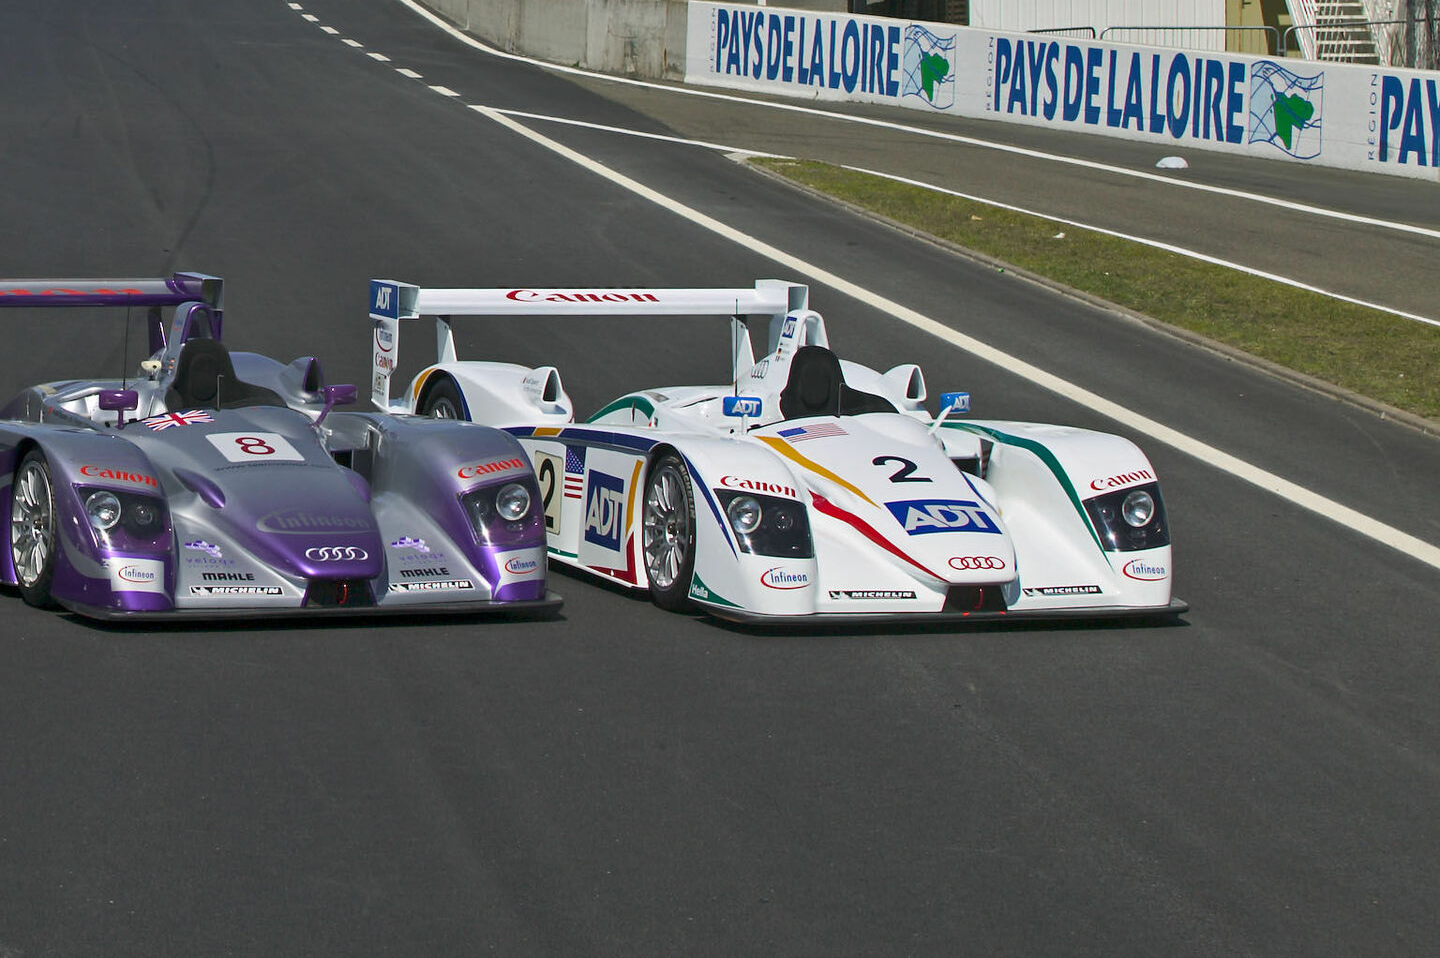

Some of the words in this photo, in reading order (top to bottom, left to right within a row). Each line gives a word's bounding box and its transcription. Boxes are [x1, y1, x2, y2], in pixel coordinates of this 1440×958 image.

[716, 8, 765, 80] PAYS
[766, 14, 795, 82] DE
[797, 17, 825, 87] LA
[829, 19, 901, 98] LOIRE
[994, 37, 1060, 121] PAYS
[1063, 45, 1104, 125] DE
[1107, 49, 1144, 132] LA
[1149, 52, 1247, 145] LOIRE
[375, 287, 392, 310] ADT
[505, 289, 661, 303] Canon
[782, 319, 796, 335] ADT
[731, 399, 761, 415] ADT
[952, 395, 970, 411] ADT
[235, 436, 276, 455] 8
[79, 465, 157, 489] Canon
[457, 458, 525, 479] Canon
[872, 455, 934, 483] 2
[720, 475, 796, 498] Canon
[1090, 469, 1152, 491] Canon
[539, 458, 555, 528] 2
[585, 484, 624, 541] ADT
[905, 504, 990, 531] ADT
[201, 572, 255, 581] MAHLE
[400, 567, 450, 578] MAHLE
[211, 587, 280, 595] MICHELIN
[407, 580, 469, 590] MICHELIN
[691, 583, 709, 599] Hella
[1043, 586, 1098, 594] MICHELIN
